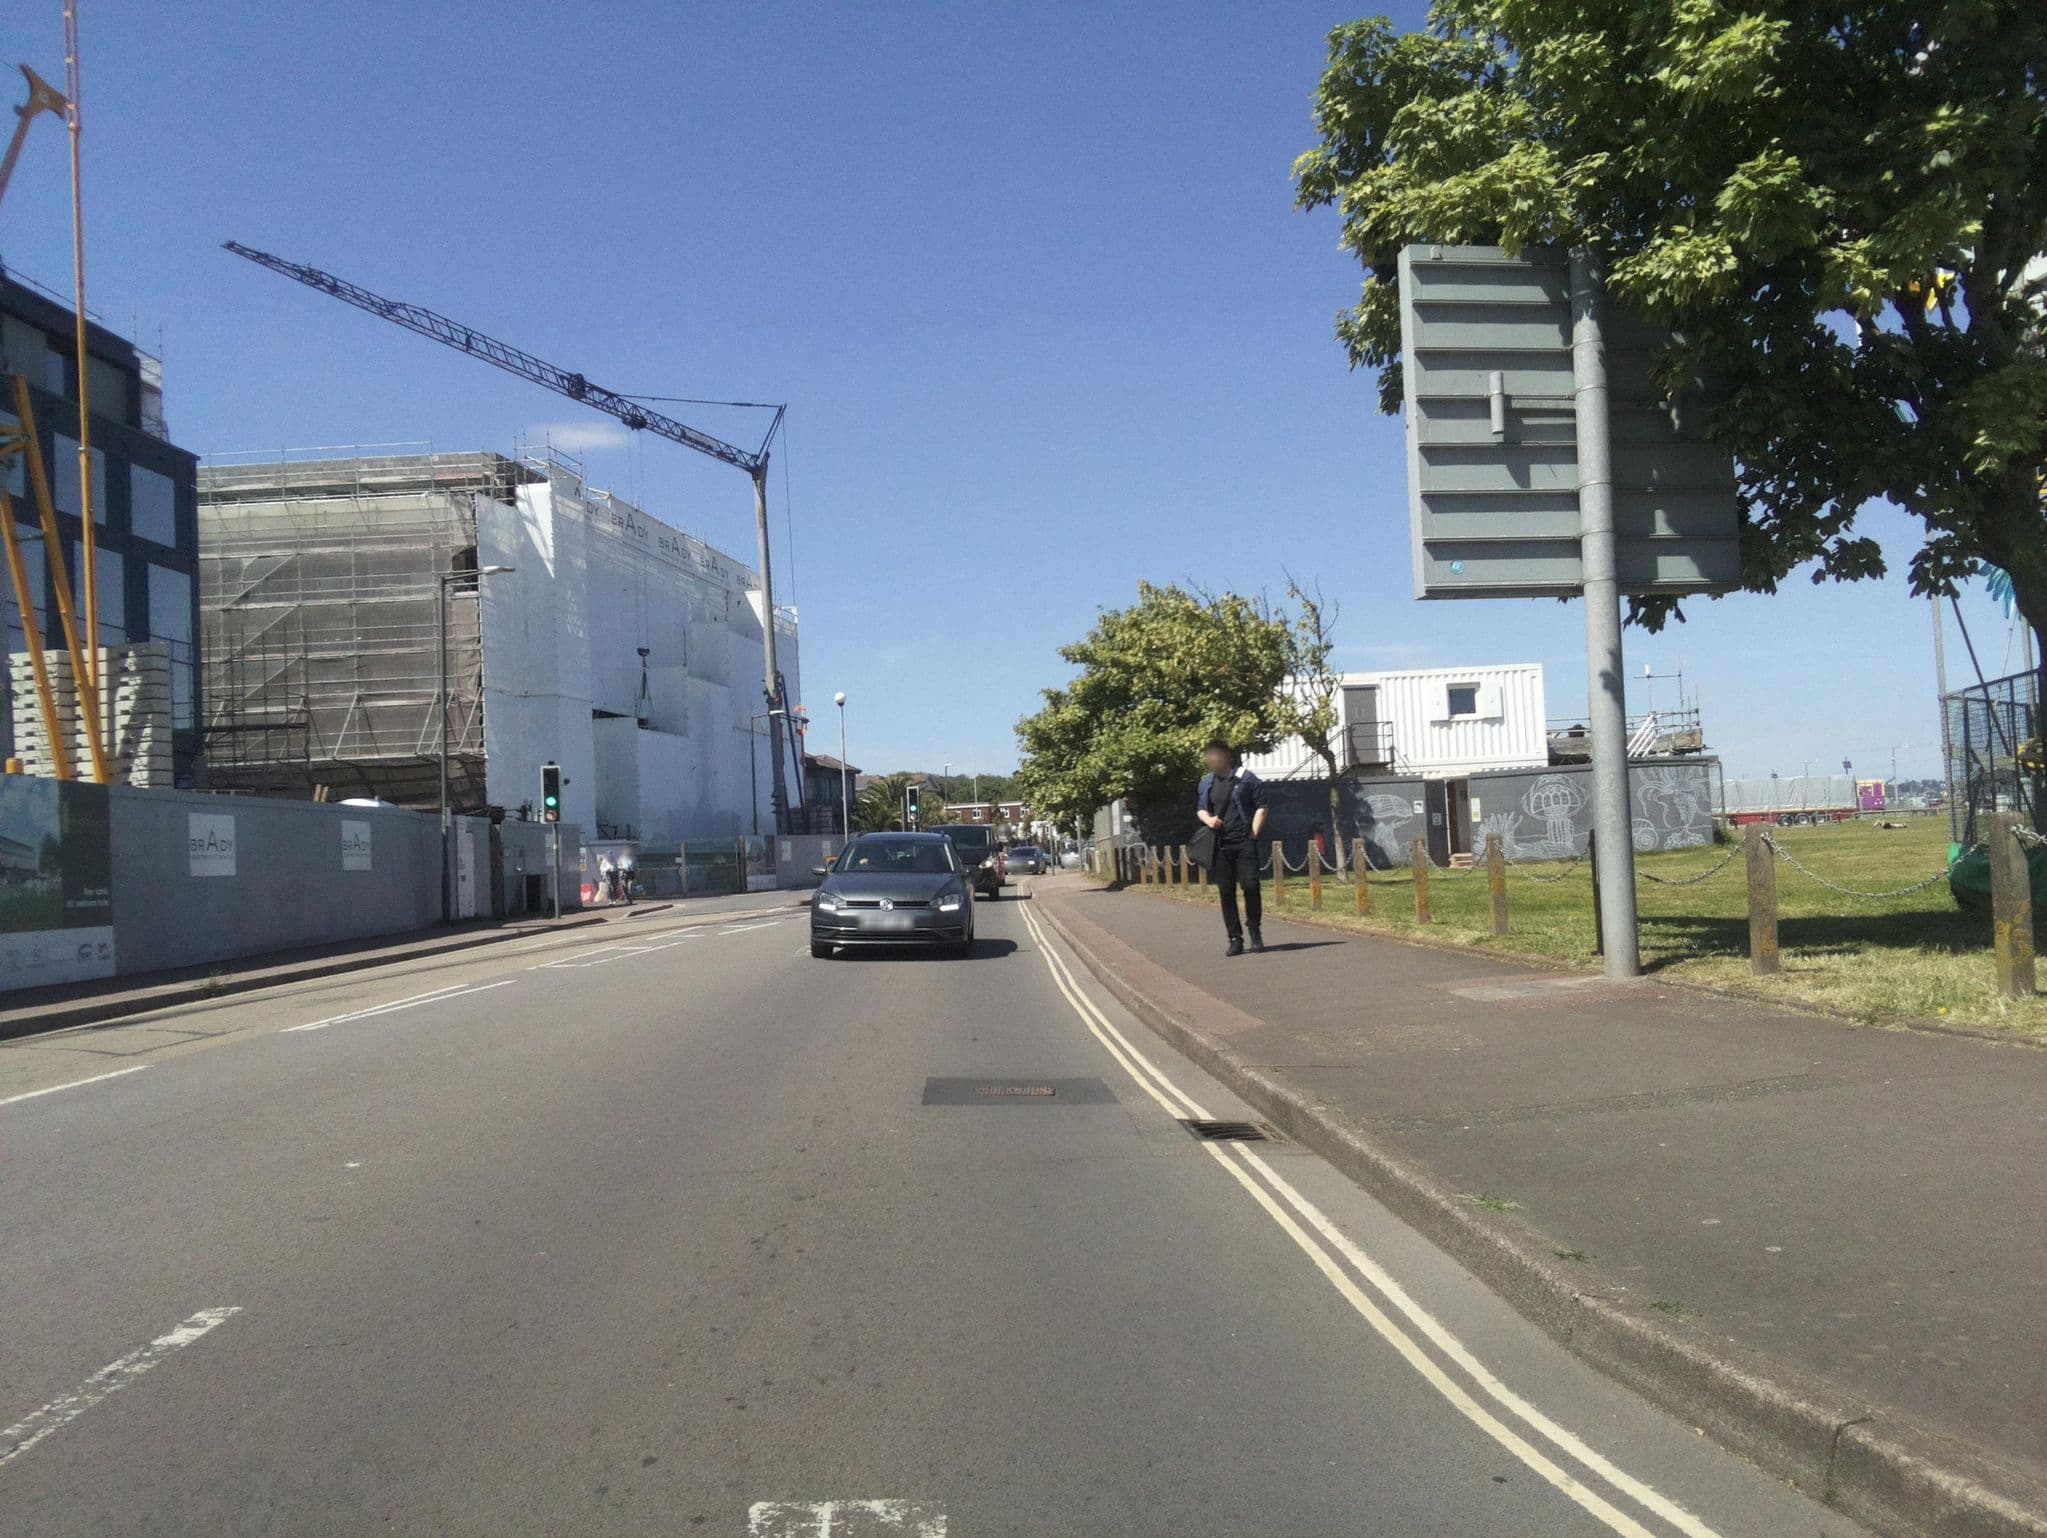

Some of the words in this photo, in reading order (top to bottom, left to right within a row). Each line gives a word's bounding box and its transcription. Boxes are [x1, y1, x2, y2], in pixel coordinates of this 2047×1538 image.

[611, 512, 649, 540] BRADY
[658, 536, 692, 561] BRADY
[190, 829, 233, 852] BRADY
